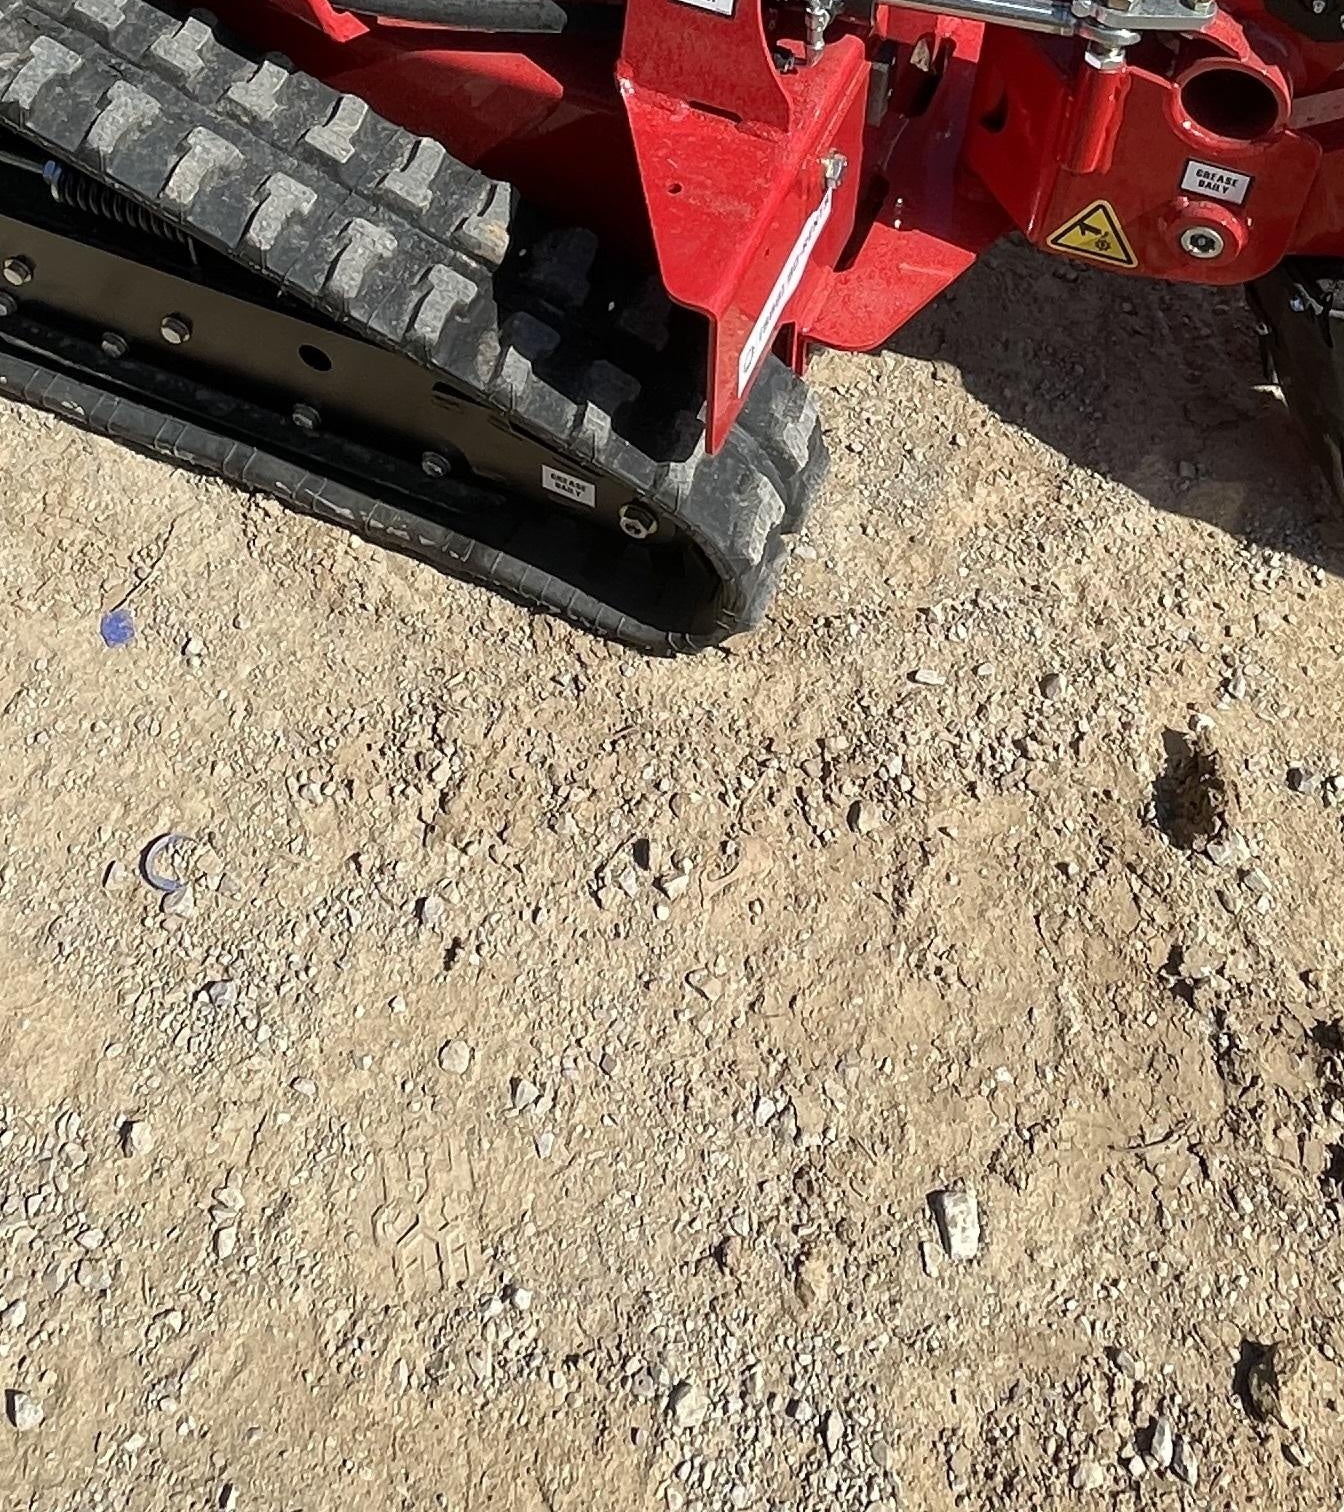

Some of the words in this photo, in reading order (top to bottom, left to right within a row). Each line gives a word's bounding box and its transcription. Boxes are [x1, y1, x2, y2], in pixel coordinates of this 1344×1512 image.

[1196, 169, 1239, 187] GREASE
[1198, 179, 1230, 194] DAILY
[550, 472, 586, 493] GREASE
